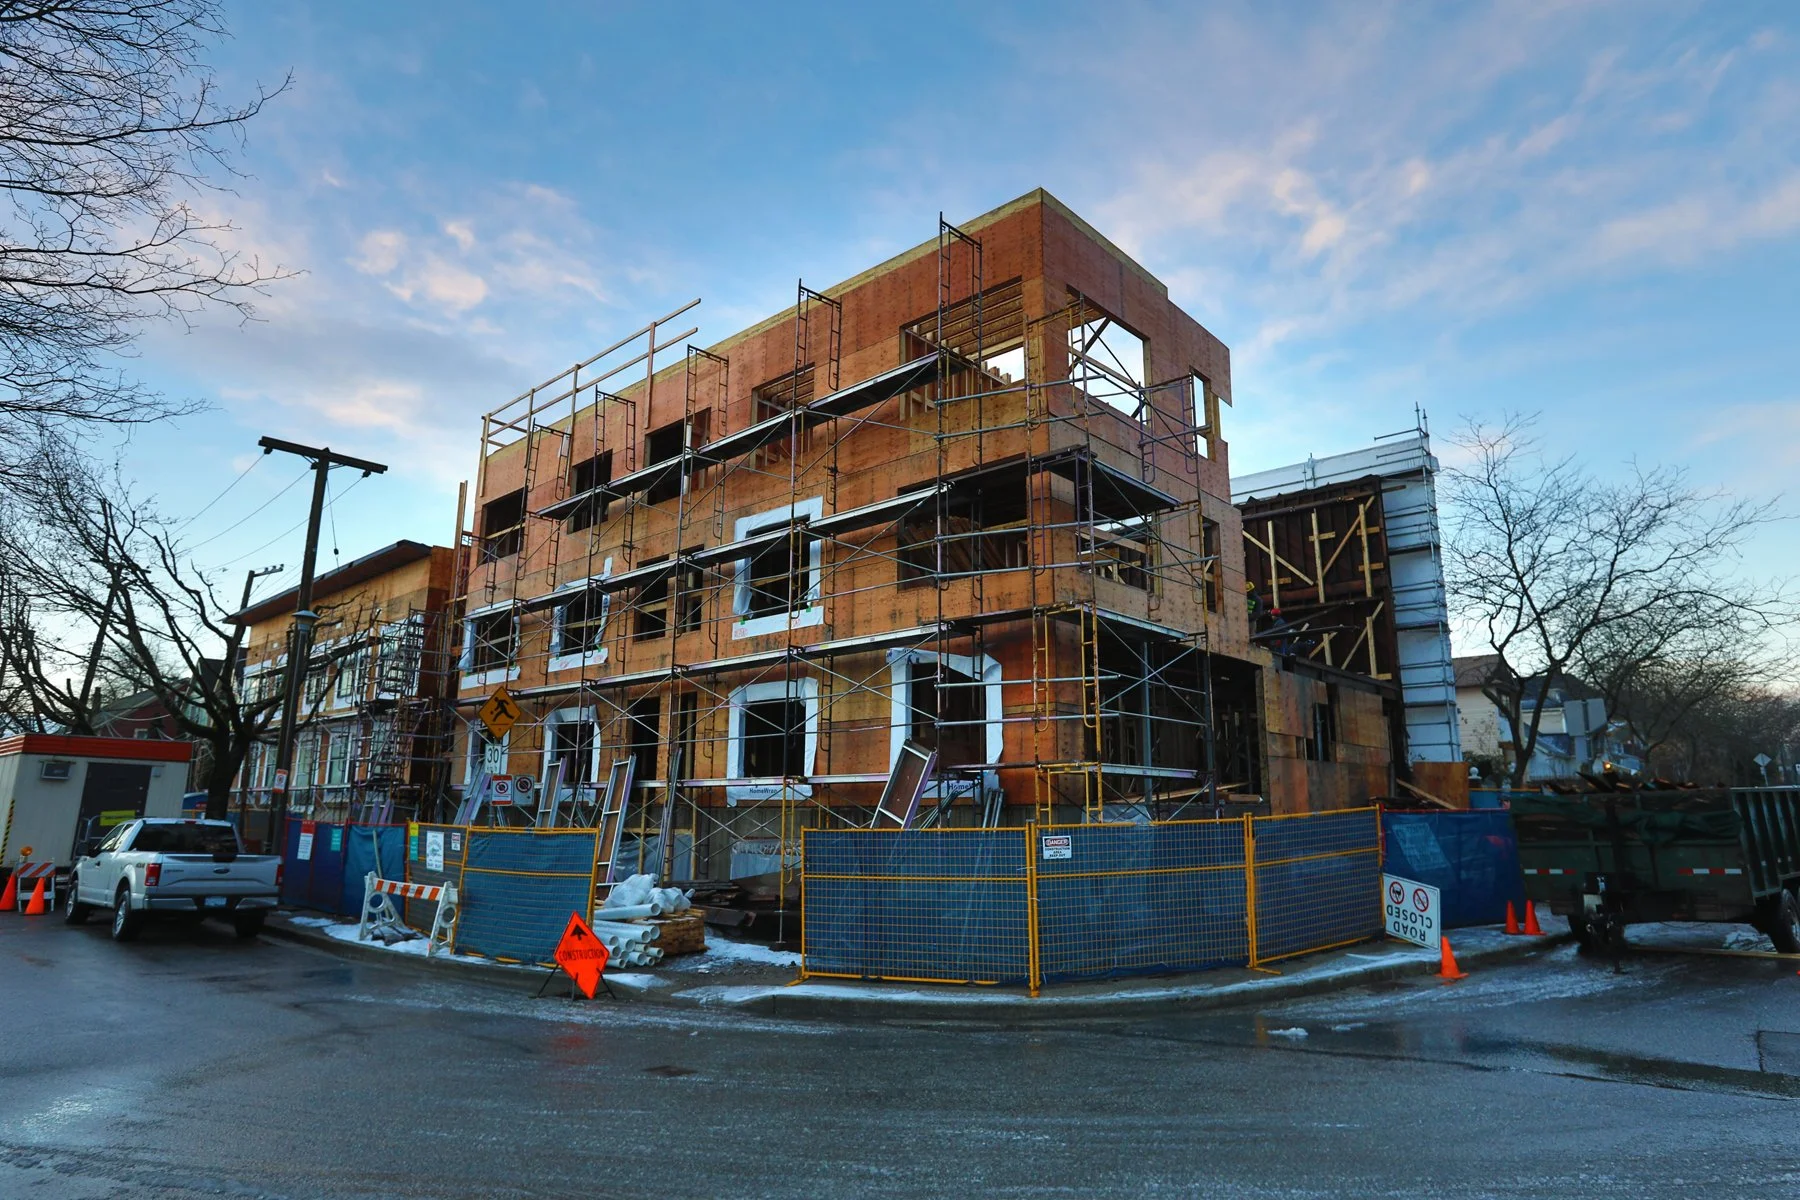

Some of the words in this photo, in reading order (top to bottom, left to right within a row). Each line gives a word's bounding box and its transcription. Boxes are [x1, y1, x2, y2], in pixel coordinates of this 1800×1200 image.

[486, 748, 500, 763] 30
[1386, 904, 1433, 929] CLOSED
[1393, 921, 1426, 942] ROAD
[559, 949, 605, 961] CONSTRUCTION
